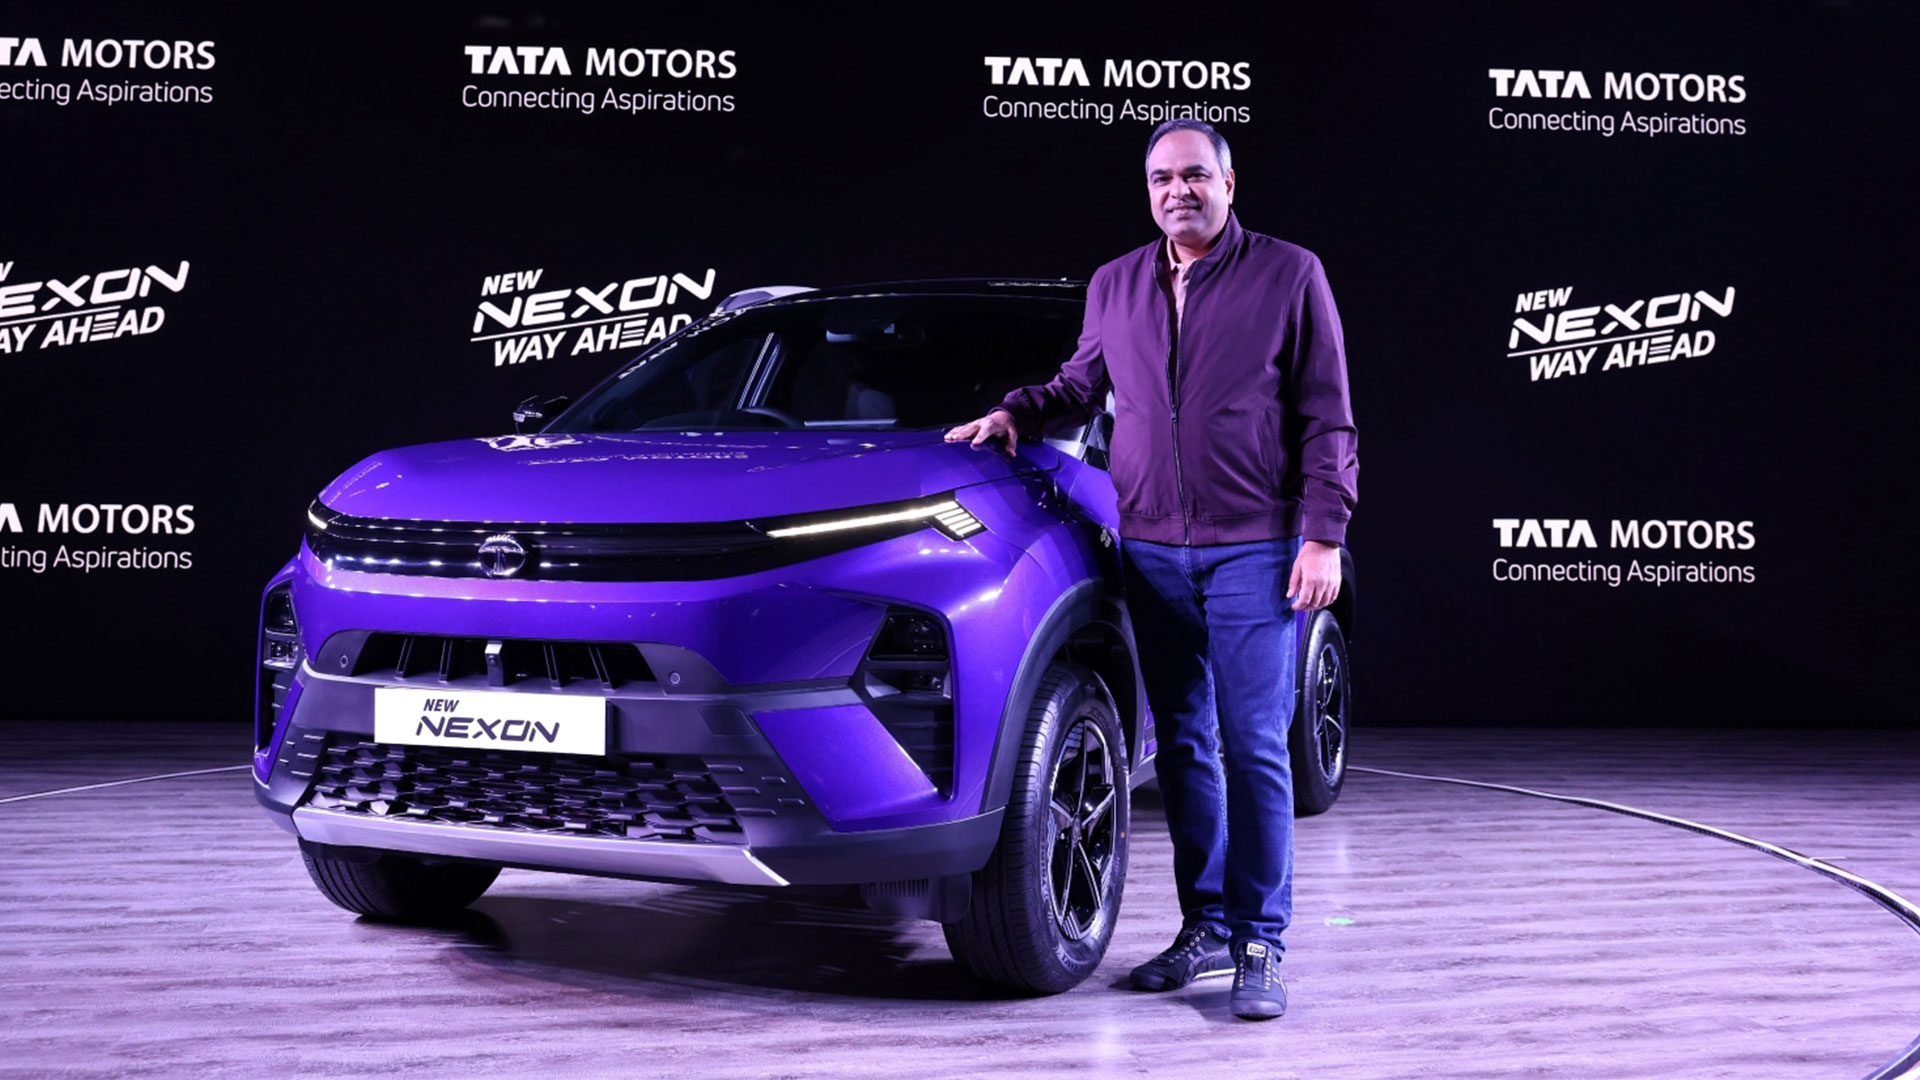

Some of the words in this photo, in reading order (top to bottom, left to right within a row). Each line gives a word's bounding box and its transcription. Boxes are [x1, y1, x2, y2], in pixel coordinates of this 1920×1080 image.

[61, 38, 216, 70] MOTORS
[465, 45, 572, 76] TATA
[586, 47, 737, 79] MOTORS
[984, 56, 1091, 87] TATA
[1103, 59, 1252, 91] MOTORS
[1488, 68, 1592, 100] TATA
[1604, 71, 1747, 104] MOTORS
[76, 79, 213, 106] Aspirations
[462, 84, 594, 115] Connecting
[601, 87, 736, 115] Aspirations
[983, 95, 1113, 126] Connecting
[1119, 98, 1251, 126] Aspirations
[1488, 106, 1614, 138] Connecting
[1620, 110, 1747, 138] Aspirations
[481, 268, 544, 297] NEW
[472, 268, 717, 335] NEXON
[1514, 285, 1574, 314] NEW
[40, 305, 166, 350] AHEAD
[1508, 286, 1736, 351] NEXON
[494, 330, 567, 368] WAY
[570, 313, 693, 357] AHEAD
[1529, 346, 1598, 382] WAY
[1601, 329, 1716, 373] AHEAD
[37, 503, 196, 535] MOTORS
[1492, 518, 1598, 549] TATA
[1610, 519, 1756, 550] MOTORS
[52, 544, 193, 573] Aspirations
[1492, 558, 1621, 588] Connecting
[1626, 559, 1756, 588] Aspirations
[423, 698, 460, 712] NEW
[416, 715, 560, 743] NEXON
